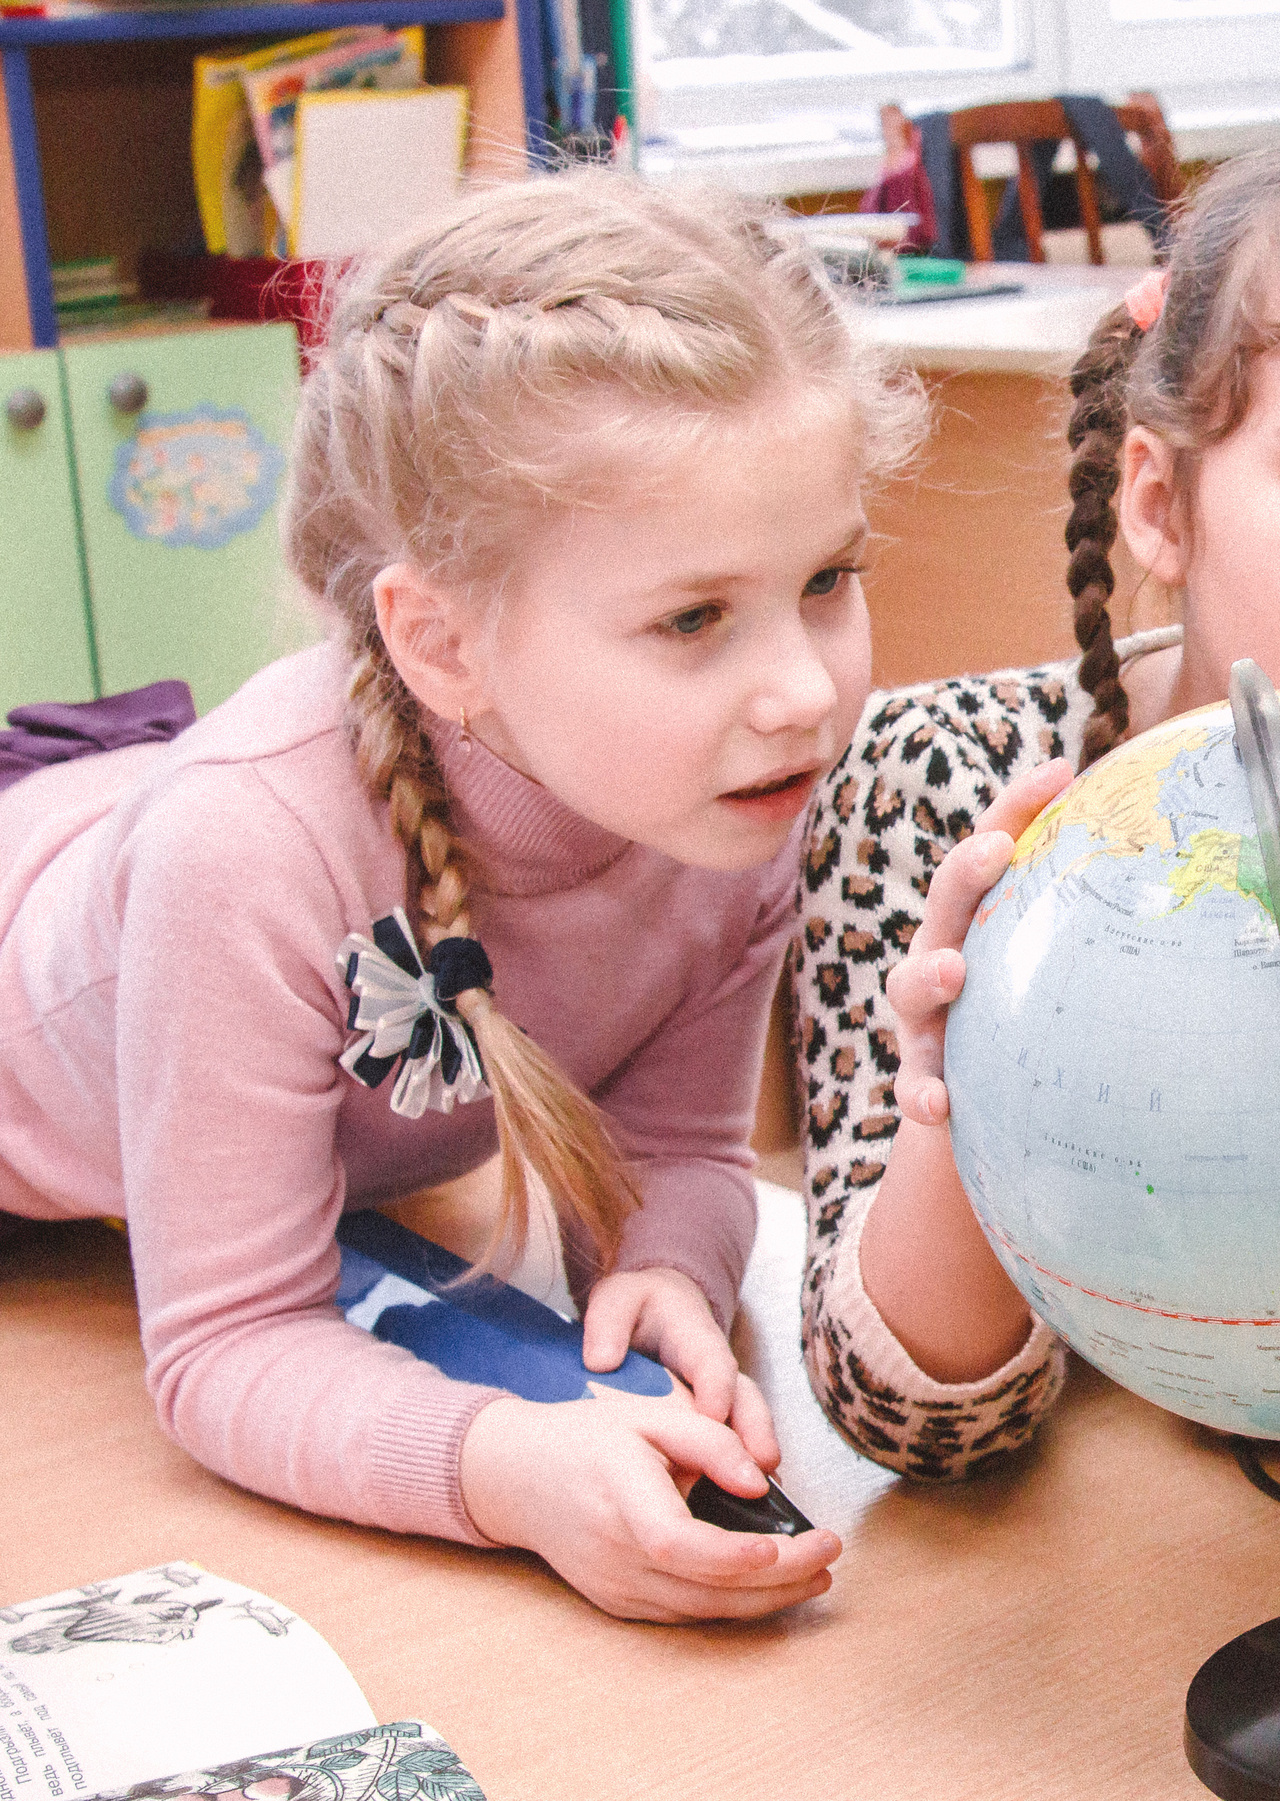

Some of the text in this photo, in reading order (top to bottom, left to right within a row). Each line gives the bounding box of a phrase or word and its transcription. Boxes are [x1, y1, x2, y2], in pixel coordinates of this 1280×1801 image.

[33, 1704, 52, 1721] под
[47, 1726, 88, 1791] подплывёт
[43, 1764, 64, 1797] ведь
